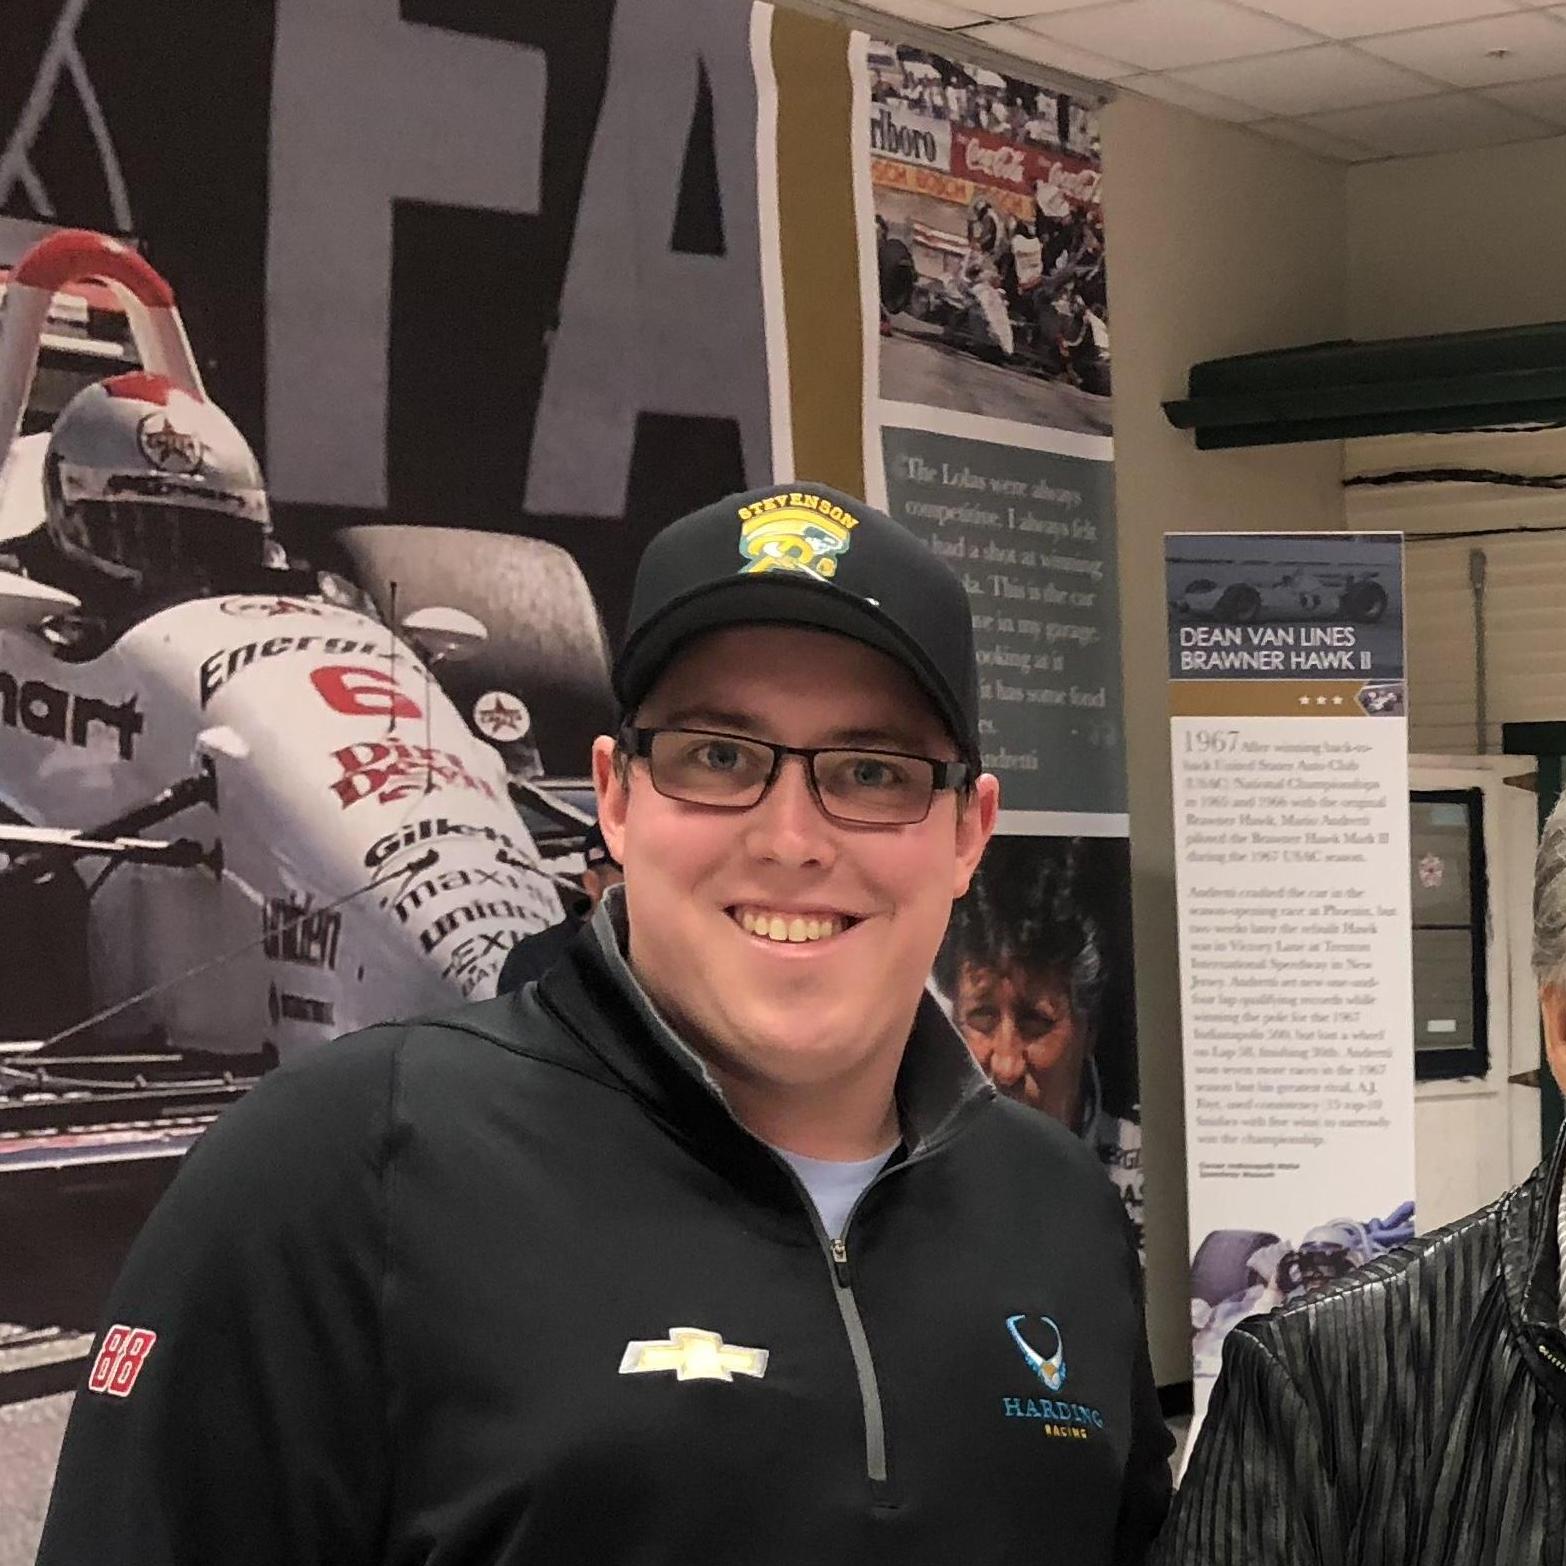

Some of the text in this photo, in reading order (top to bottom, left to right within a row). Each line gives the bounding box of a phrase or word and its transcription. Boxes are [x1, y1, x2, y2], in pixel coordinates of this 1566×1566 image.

[738, 493, 859, 529] STEVENSON
[1180, 627, 1356, 647] DEAN VAN LINES
[1181, 650, 1285, 670] BRAWNER
[1290, 650, 1356, 670] HAWK
[310, 665, 423, 719] 6
[1184, 729, 1240, 753] 1967
[89, 1324, 157, 1398] 88
[1002, 1397, 1104, 1429] HARDING
[1044, 1413, 1088, 1439] RACING
